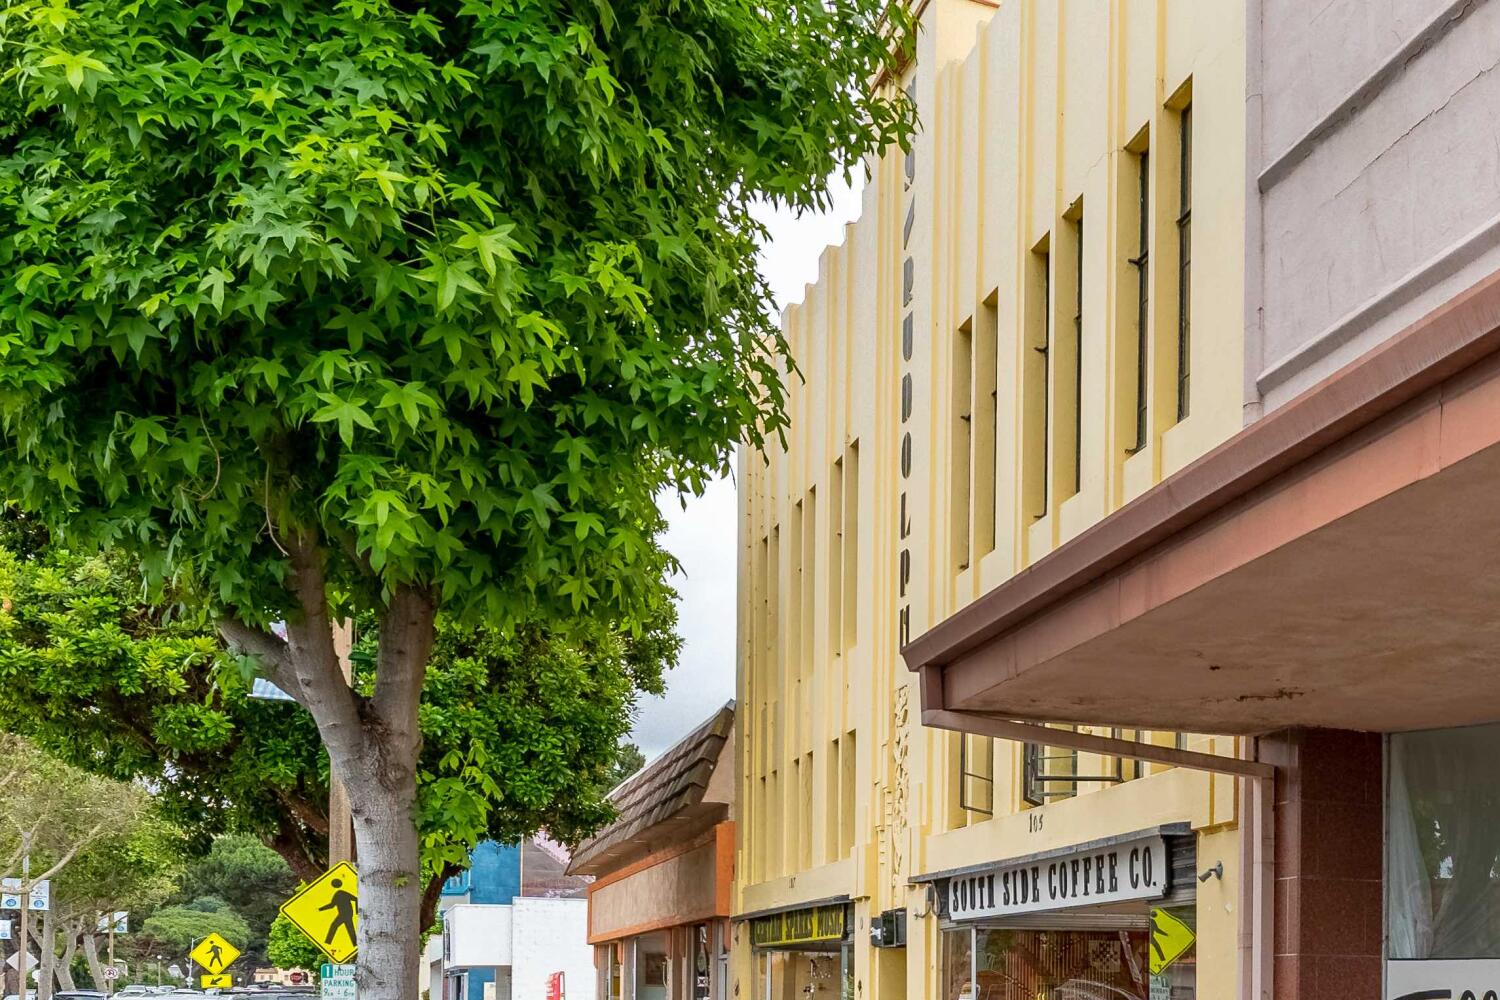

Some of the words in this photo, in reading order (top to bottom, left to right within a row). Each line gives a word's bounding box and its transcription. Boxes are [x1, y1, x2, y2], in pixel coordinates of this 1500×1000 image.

[1029, 812, 1044, 833] 105
[952, 874, 995, 913] SOUTH
[1003, 866, 1039, 906] SIDE
[1049, 851, 1118, 900] COFFEE
[1129, 845, 1157, 889] CO.
[324, 979, 354, 988] PARKING
